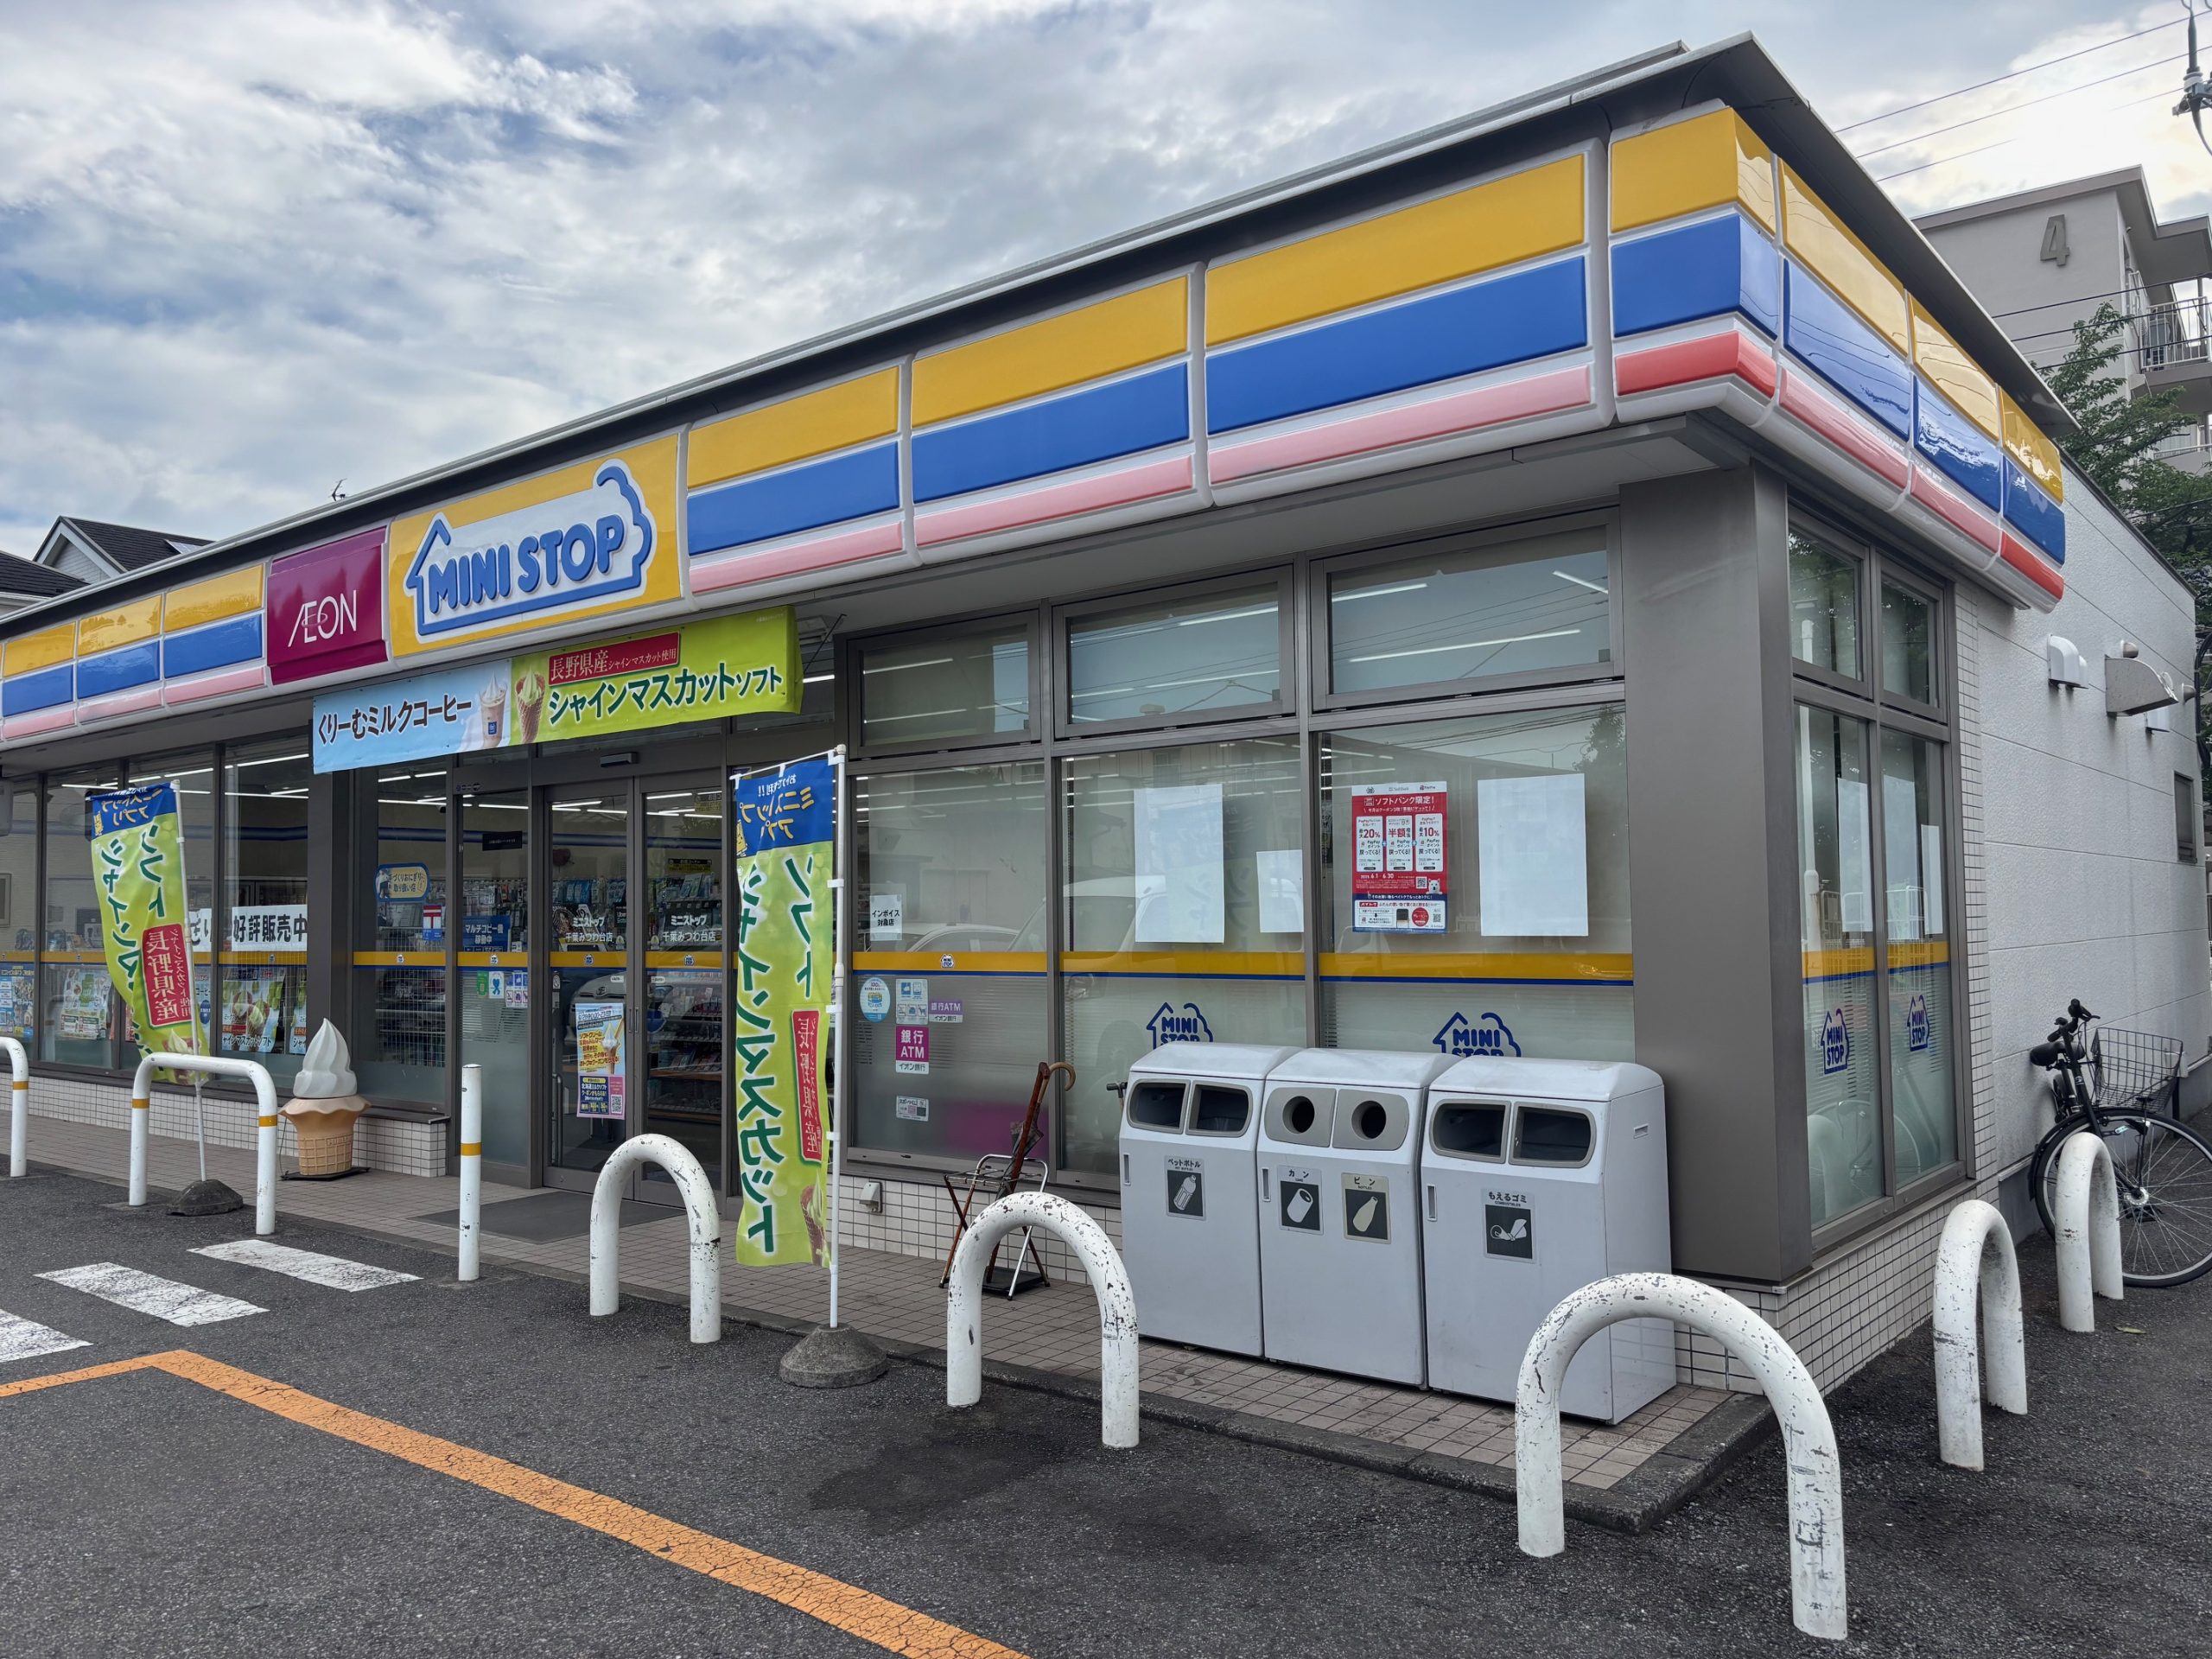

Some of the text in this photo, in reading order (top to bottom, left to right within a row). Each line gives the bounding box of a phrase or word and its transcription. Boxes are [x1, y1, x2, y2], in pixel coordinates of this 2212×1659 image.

[2040, 214, 2069, 266] 4
[429, 513, 625, 615] MINI STOP
[550, 648, 677, 682] 長野県産 シャインマスカット使用
[549, 662, 782, 724] シャインマスカットソフト
[318, 692, 473, 746] くりーむミルクコーヒー
[1363, 829, 1380, 838] 20%
[1389, 828, 1406, 838] 半額
[1424, 827, 1440, 836] 10%
[872, 909, 900, 918] インボイス
[572, 916, 606, 927] ミニストップ
[671, 914, 708, 926] ミニストップ
[233, 913, 308, 943] 好評販売中
[565, 931, 613, 943] 千葉みつわ台店
[663, 931, 716, 943] 千葉みつわ台店
[931, 1002, 961, 1011] 銀行ATM
[1911, 1009, 1925, 1027] MINI
[1161, 1016, 1198, 1033] MINI
[900, 1029, 924, 1045] 銀行
[1452, 1029, 1501, 1047] MINI
[1827, 1025, 1843, 1046] MINI
[1911, 1026, 1926, 1045] STOP
[900, 1046, 925, 1058] ATM
[1827, 1045, 1844, 1066] STOP
[899, 1063, 925, 1071] イオン銀行
[1167, 1158, 1201, 1168] ペットボトル
[1288, 1169, 1309, 1178] カン
[1488, 1192, 1527, 1203] もえるゴミ
